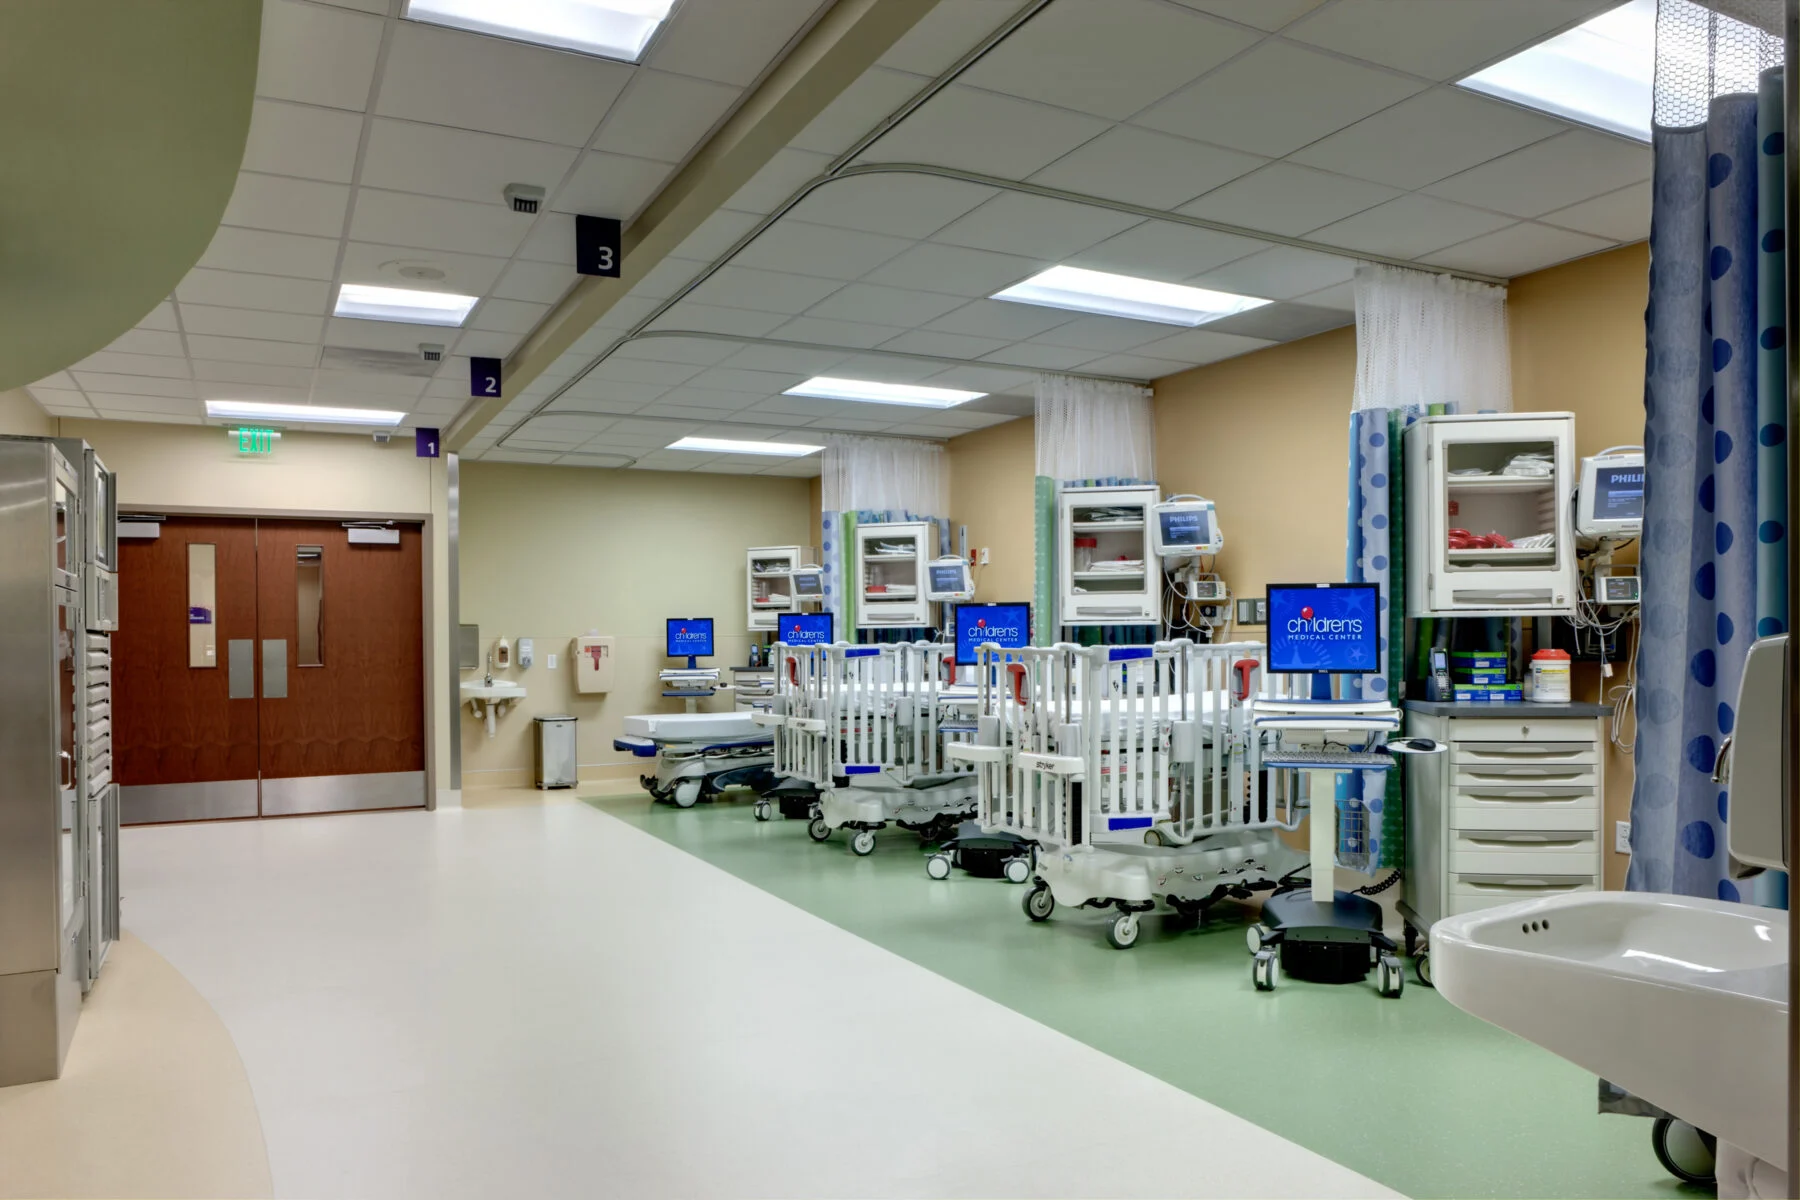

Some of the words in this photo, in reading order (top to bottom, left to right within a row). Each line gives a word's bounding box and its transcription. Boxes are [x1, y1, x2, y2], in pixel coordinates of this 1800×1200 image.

[598, 246, 613, 270] 3
[485, 376, 497, 393] 2
[239, 427, 274, 453] EXIT
[428, 442, 434, 454] 1
